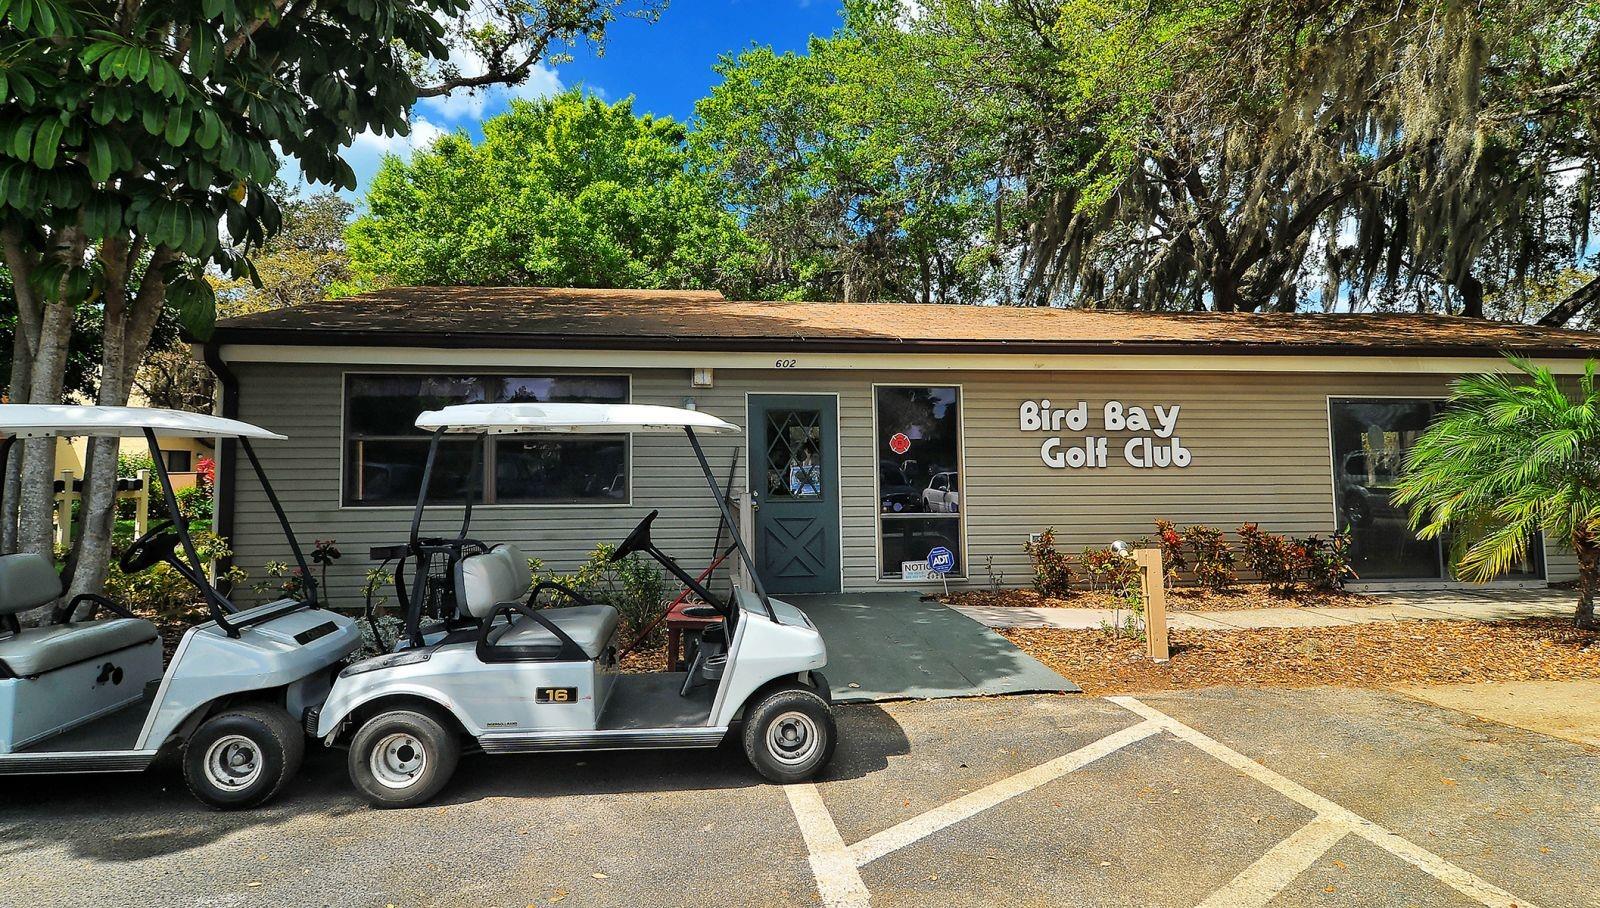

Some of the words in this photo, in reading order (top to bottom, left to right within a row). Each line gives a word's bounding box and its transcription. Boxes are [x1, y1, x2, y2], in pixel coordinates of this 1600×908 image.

[775, 359, 796, 368] 602
[1020, 400, 1088, 431] Bird
[1104, 400, 1181, 438] Bay
[1041, 436, 1108, 468] Golf
[1124, 437, 1192, 468] Club
[933, 555, 949, 565] ADT
[904, 563, 932, 571] NOTIC
[545, 689, 568, 701] 16
